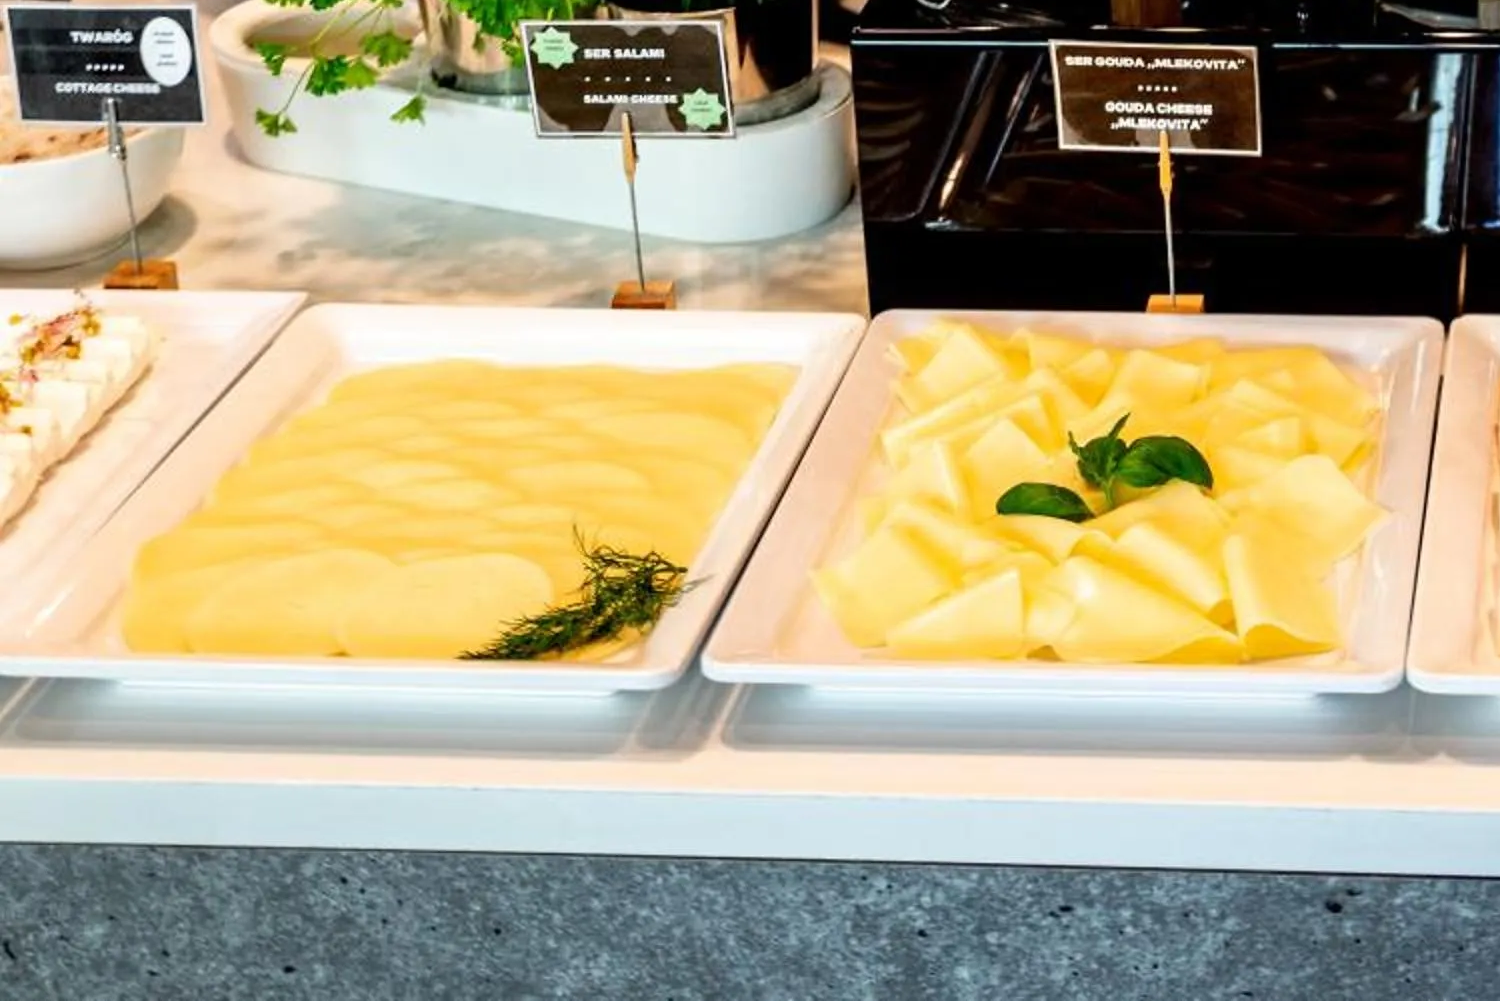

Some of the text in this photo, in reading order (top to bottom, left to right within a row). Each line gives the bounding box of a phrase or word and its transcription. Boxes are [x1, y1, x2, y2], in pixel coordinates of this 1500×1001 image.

[583, 48, 665, 60] SER SALAMI
[1064, 56, 1093, 67] SER
[1095, 57, 1145, 68] GOUDA
[55, 82, 113, 94] COTTAGE
[583, 94, 678, 104] SALAMI CHEESE
[1105, 101, 1213, 115] GOUDA CHEESE
